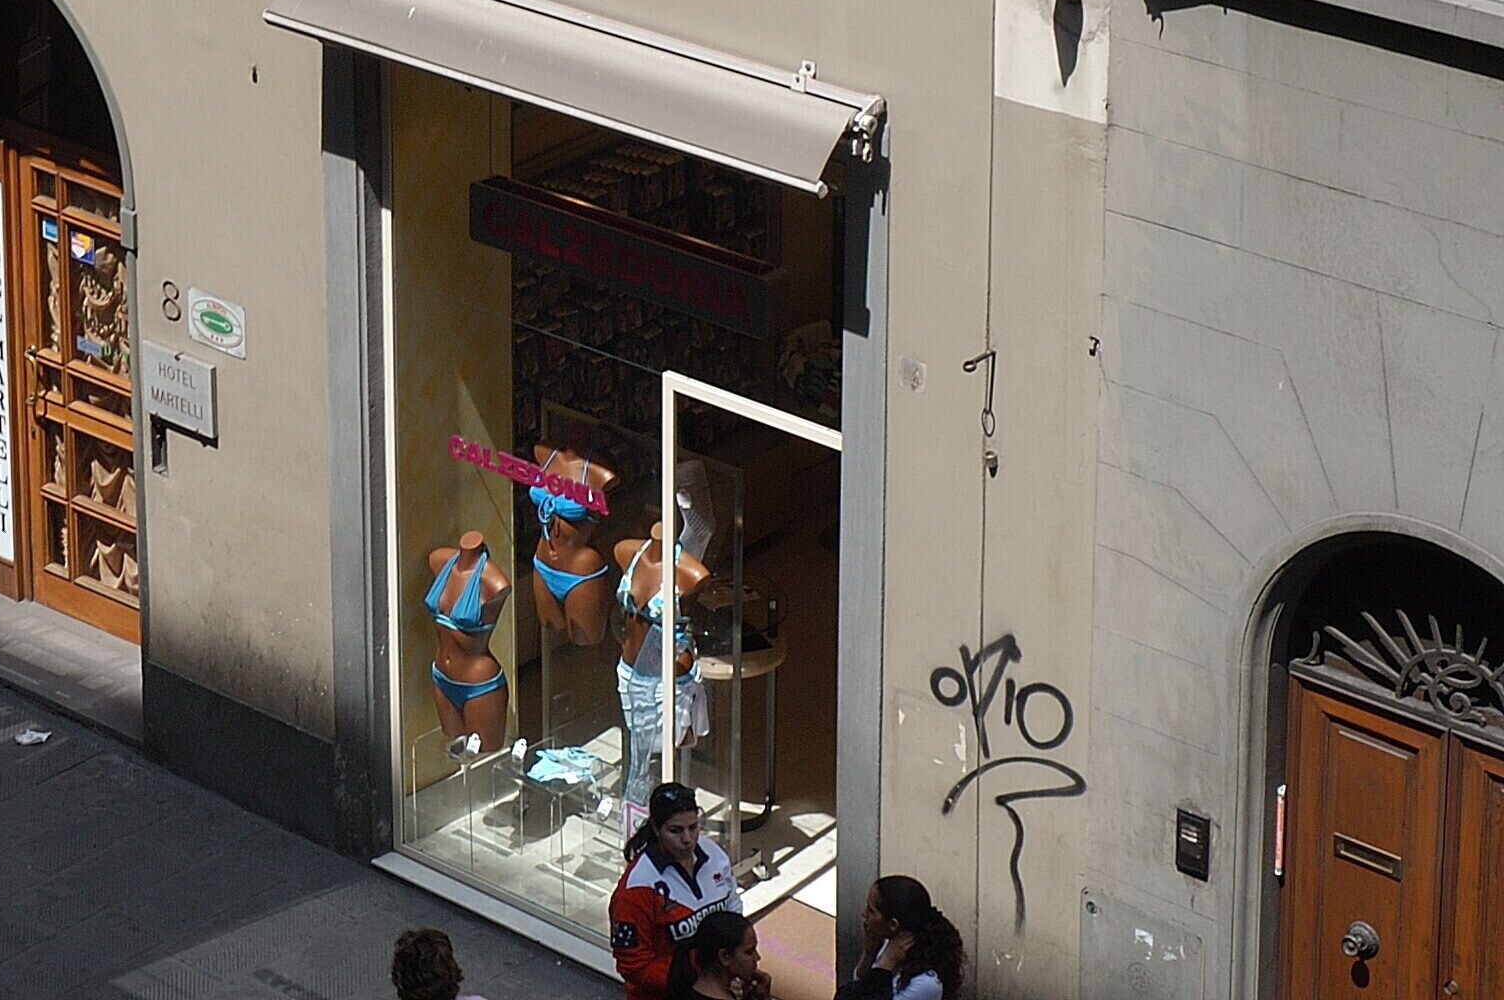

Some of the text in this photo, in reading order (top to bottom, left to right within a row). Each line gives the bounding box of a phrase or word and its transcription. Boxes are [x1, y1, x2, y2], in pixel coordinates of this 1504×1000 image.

[483, 202, 751, 324] CALZEDONIA
[162, 280, 182, 322] 8
[158, 362, 197, 389] HOTEL
[150, 385, 204, 420] MARTELLI
[448, 434, 610, 517] CALZEDONIA
